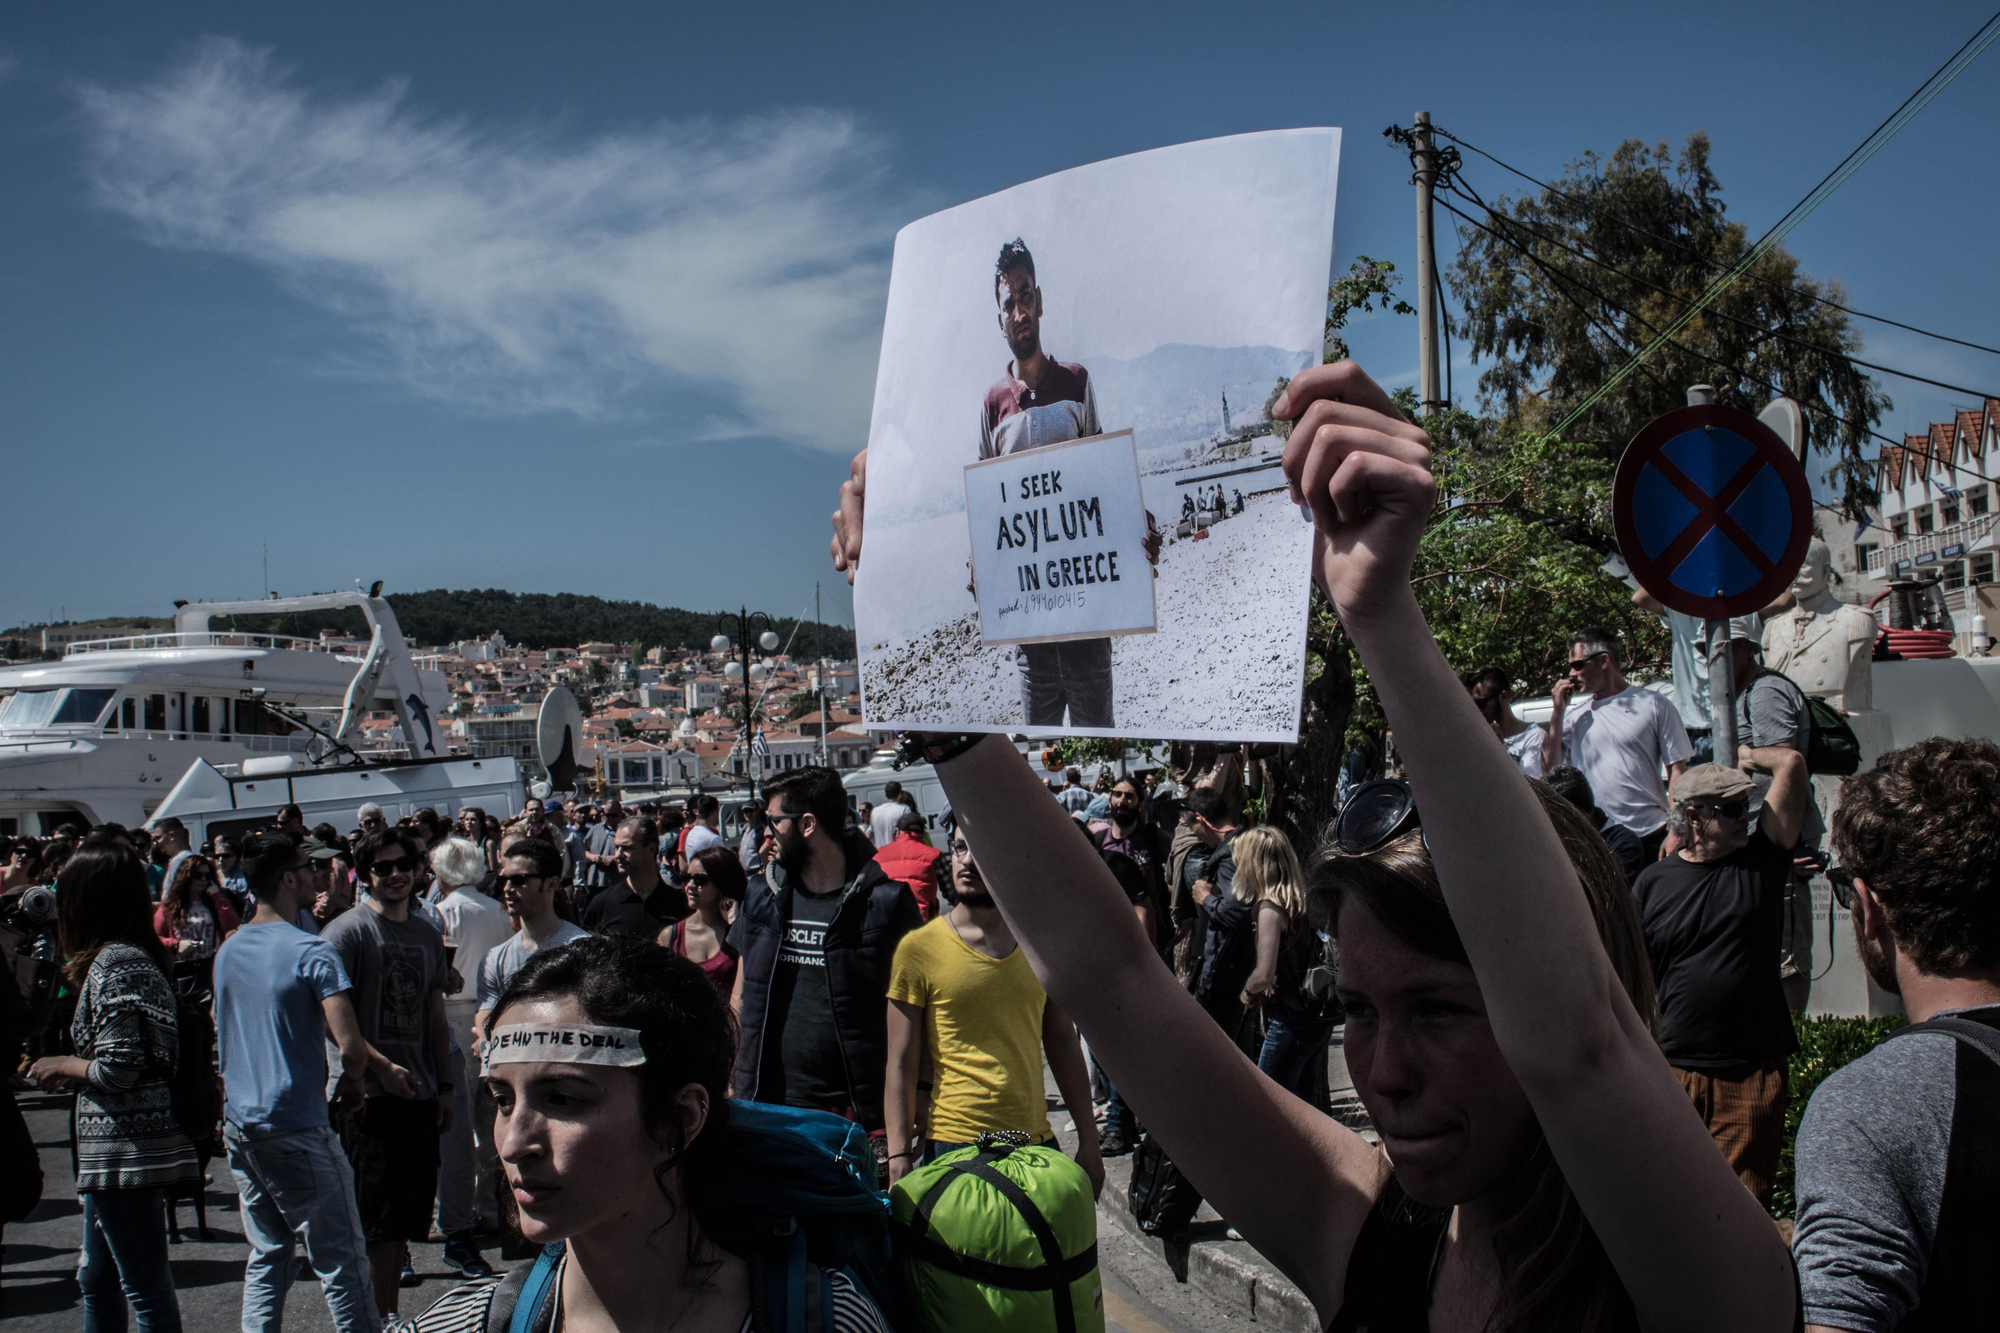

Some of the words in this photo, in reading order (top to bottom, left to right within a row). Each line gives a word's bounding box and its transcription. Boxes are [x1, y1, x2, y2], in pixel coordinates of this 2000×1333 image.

[1001, 482, 1007, 503] I
[1020, 469, 1063, 500] SEEK
[996, 496, 1104, 553] ASYLUM
[1017, 562, 1041, 592] IN
[1045, 551, 1120, 588] GREECE
[533, 1031, 574, 1047] THE
[579, 1033, 626, 1050] DEAL
